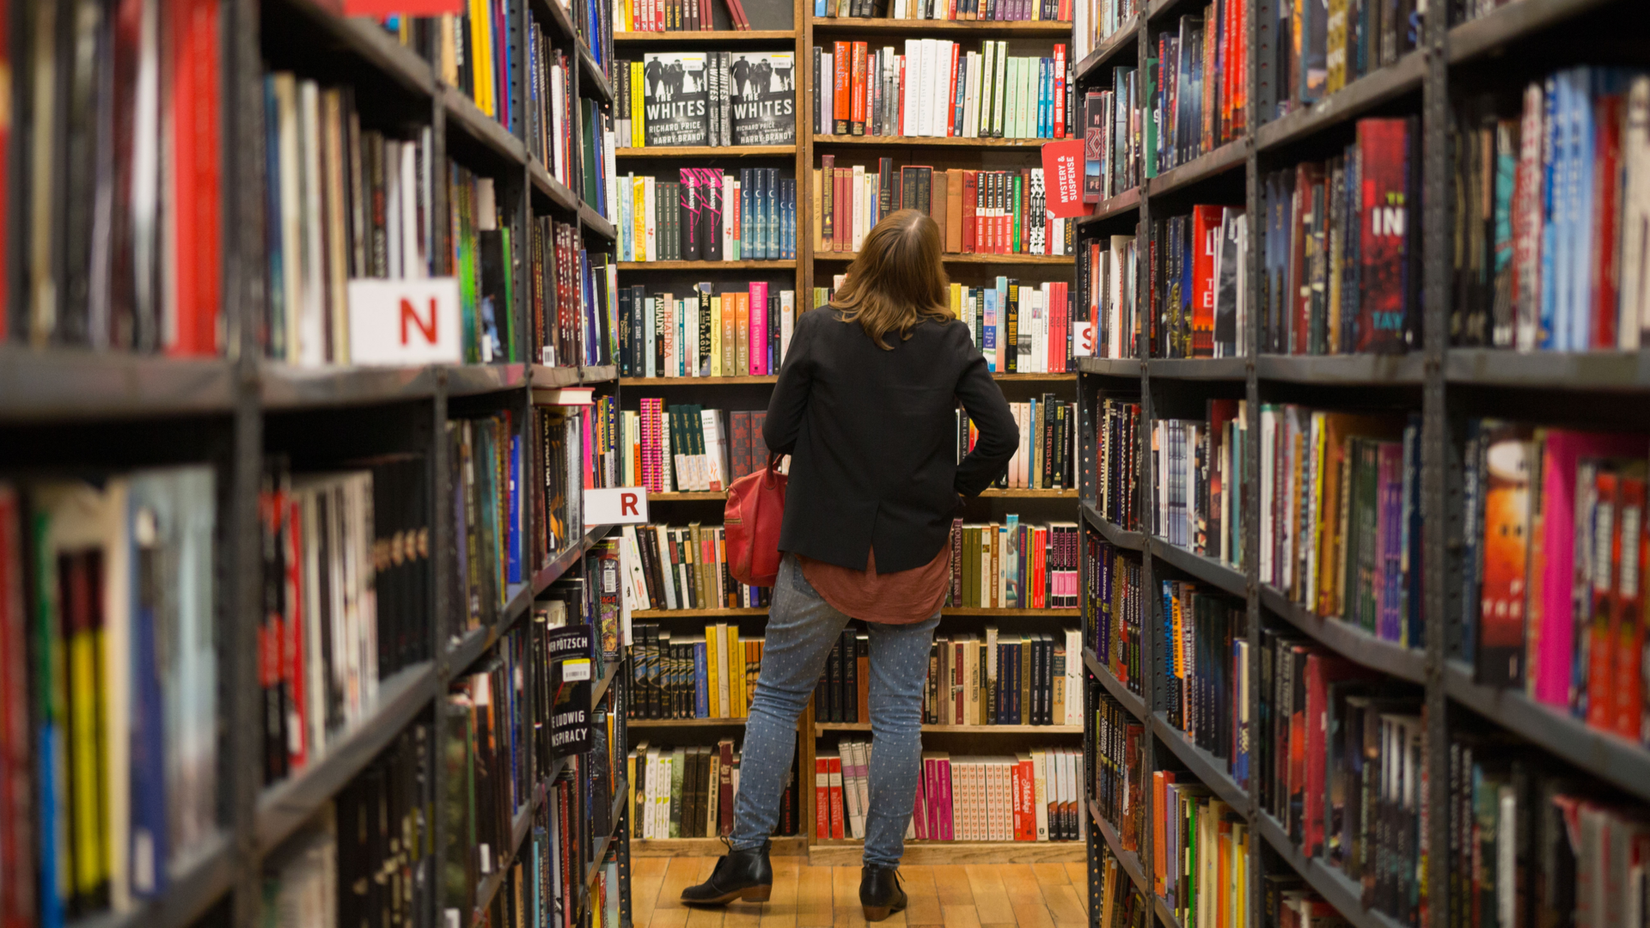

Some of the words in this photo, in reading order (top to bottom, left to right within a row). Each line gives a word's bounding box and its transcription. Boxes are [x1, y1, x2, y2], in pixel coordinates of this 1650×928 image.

[1056, 61, 1064, 78] MEANS
[710, 67, 718, 101] WHITES
[720, 67, 728, 101] WHITES
[656, 93, 671, 102] THE
[742, 93, 758, 102] THE
[647, 100, 705, 120] WHITES
[734, 99, 792, 120] WHITES
[649, 122, 678, 133] RICHARD
[681, 121, 700, 130] PRICE
[653, 134, 676, 144] HARRY
[678, 132, 705, 142] BRANDT
[740, 134, 762, 143] HARRY
[765, 132, 792, 140] BRANDT
[1058, 165, 1068, 203] MYSTERY
[1066, 156, 1077, 201] SUSPENSE
[400, 297, 437, 346] N
[664, 312, 672, 359] PHAEDRA
[620, 492, 639, 517] R
[557, 637, 588, 650] PÖTZSCH
[556, 710, 584, 727] LUDWIG
